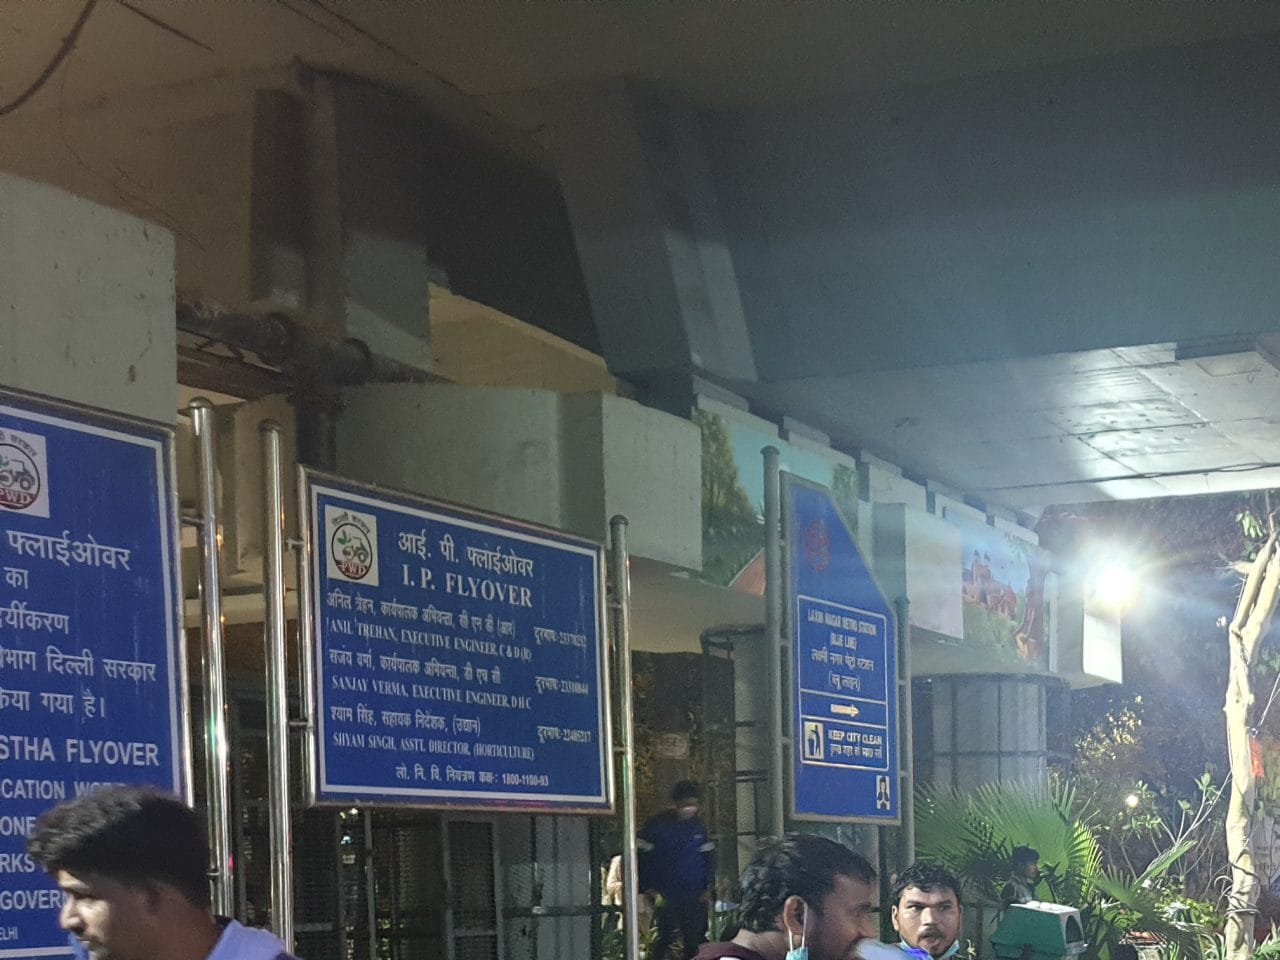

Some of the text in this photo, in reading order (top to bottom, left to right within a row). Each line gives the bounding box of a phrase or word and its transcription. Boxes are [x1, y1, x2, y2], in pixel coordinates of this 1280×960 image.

[6, 530, 131, 571] फ्लाईओवर
[398, 529, 534, 578] आई. पी. फ्लाईओवर
[4, 567, 29, 590] का
[402, 564, 533, 608] I. P. FLYOVER
[0, 600, 69, 635] र्यीकरण
[327, 587, 352, 610] अनिल
[380, 596, 419, 621] कार्यपालक
[330, 619, 353, 635] ANIL
[401, 629, 450, 650] EXECUTIVE
[454, 637, 498, 656] ENGINEER,
[0, 645, 157, 681] भाग दिल्ली सरकार
[379, 652, 420, 675] कार्यपालक
[40, 692, 74, 714] गया
[332, 675, 368, 692] SANJAY
[412, 683, 462, 702] EXECUTIVE
[330, 705, 353, 722] श्याम
[382, 710, 412, 728] सहायक
[452, 714, 480, 738] (उद्यान)
[66, 738, 160, 767] FLYOVER
[333, 731, 365, 748] SHYAM
[473, 743, 534, 761] (HORTICULTURE)
[828, 730, 845, 741] KEEP
[862, 734, 882, 745] CLEAN
[396, 762, 410, 781] लो.
